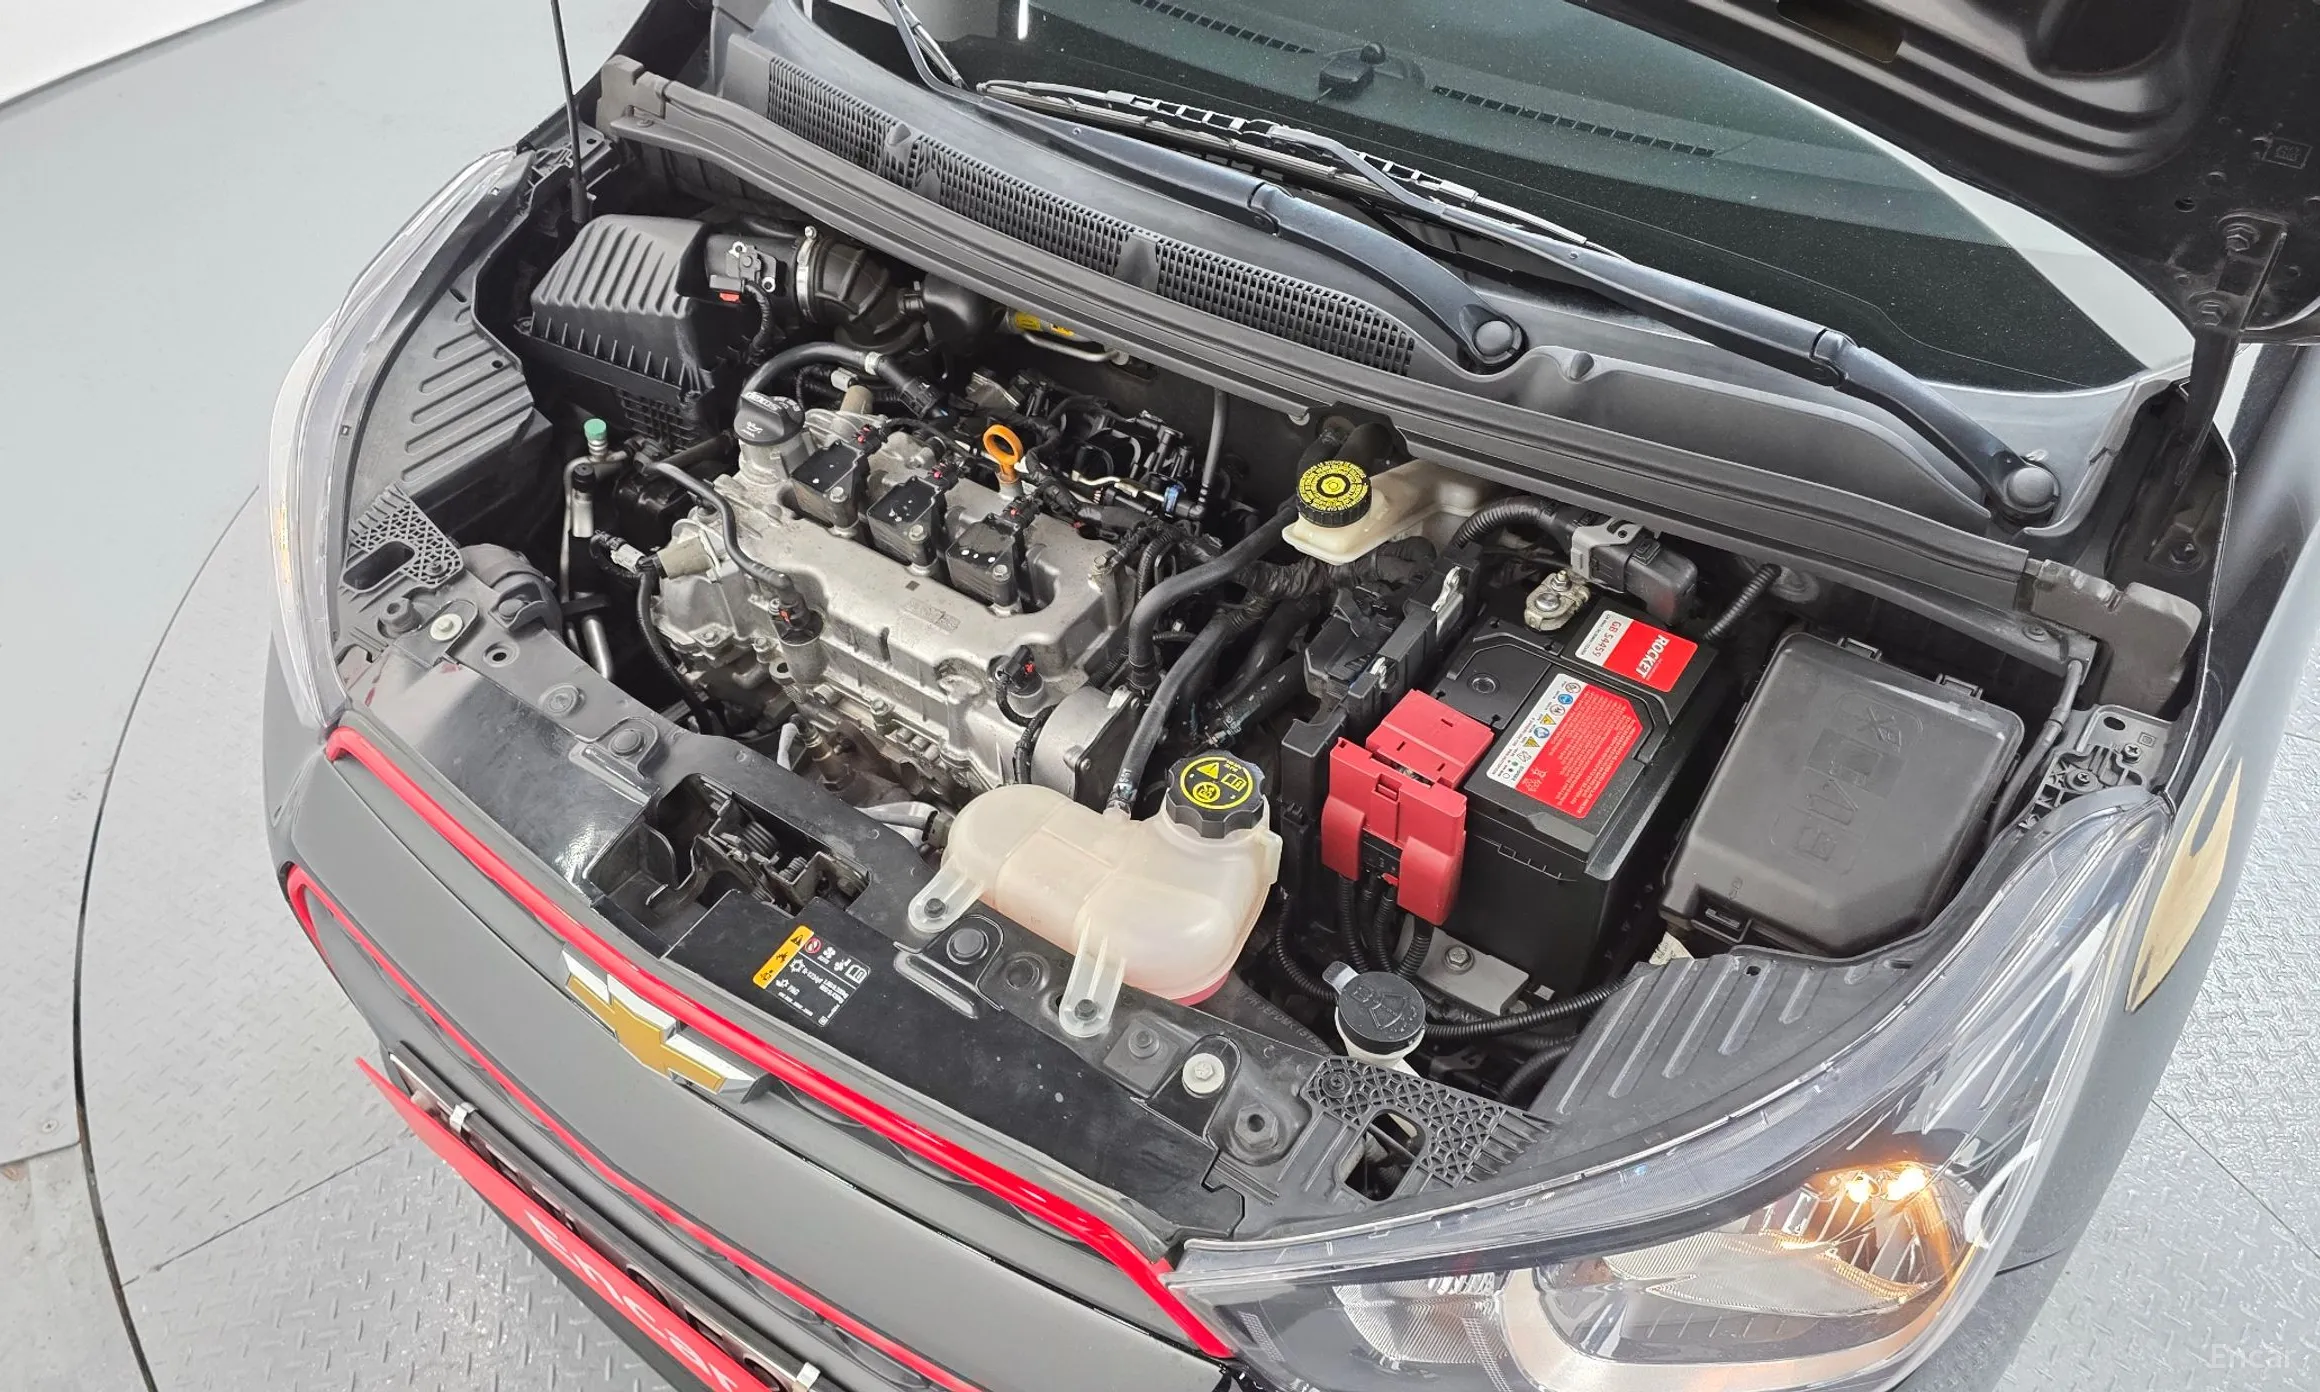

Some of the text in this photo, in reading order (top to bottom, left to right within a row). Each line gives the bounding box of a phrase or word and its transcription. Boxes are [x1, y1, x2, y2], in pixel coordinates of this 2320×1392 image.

[1607, 620, 1622, 634] GB
[1591, 631, 1614, 658] 54459
[1634, 634, 1670, 680] ROCKET
